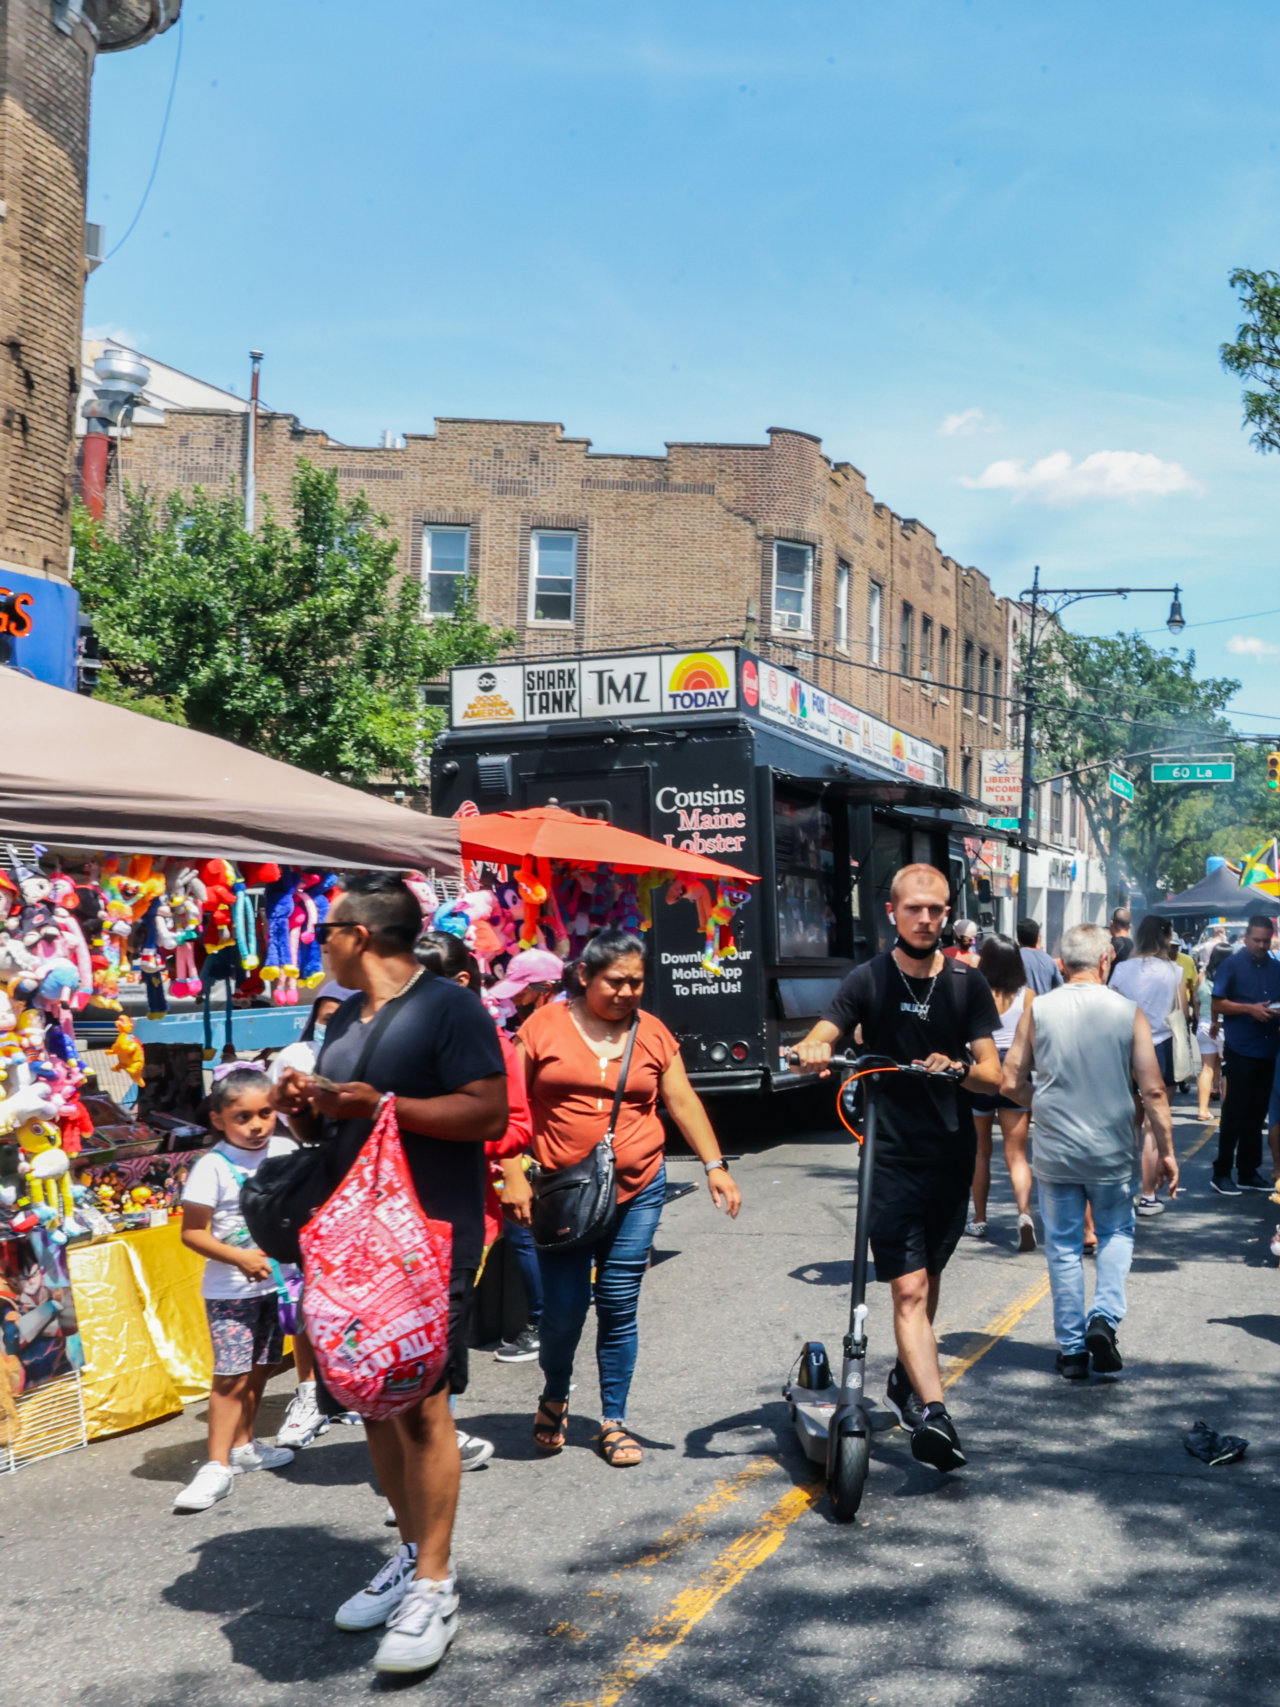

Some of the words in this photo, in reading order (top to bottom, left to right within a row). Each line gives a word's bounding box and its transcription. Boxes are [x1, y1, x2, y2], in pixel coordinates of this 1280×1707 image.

[527, 668, 576, 691] SHARK
[588, 669, 650, 705] TMZ
[475, 694, 502, 703] GOOD
[527, 689, 578, 715] TANK
[669, 690, 730, 710] TODAY
[812, 692, 826, 715] FOX
[462, 708, 515, 719] AMERICA
[788, 714, 808, 731] CNBC
[983, 776, 1023, 784] LIBERTY
[1172, 767, 1190, 778] 60
[1196, 767, 1213, 778] La
[655, 783, 746, 813] Cousins
[985, 785, 1022, 793] INCOME
[676, 807, 746, 831] Maine
[673, 984, 690, 996] To
[692, 983, 719, 995] Find
[721, 981, 741, 994] Us!
